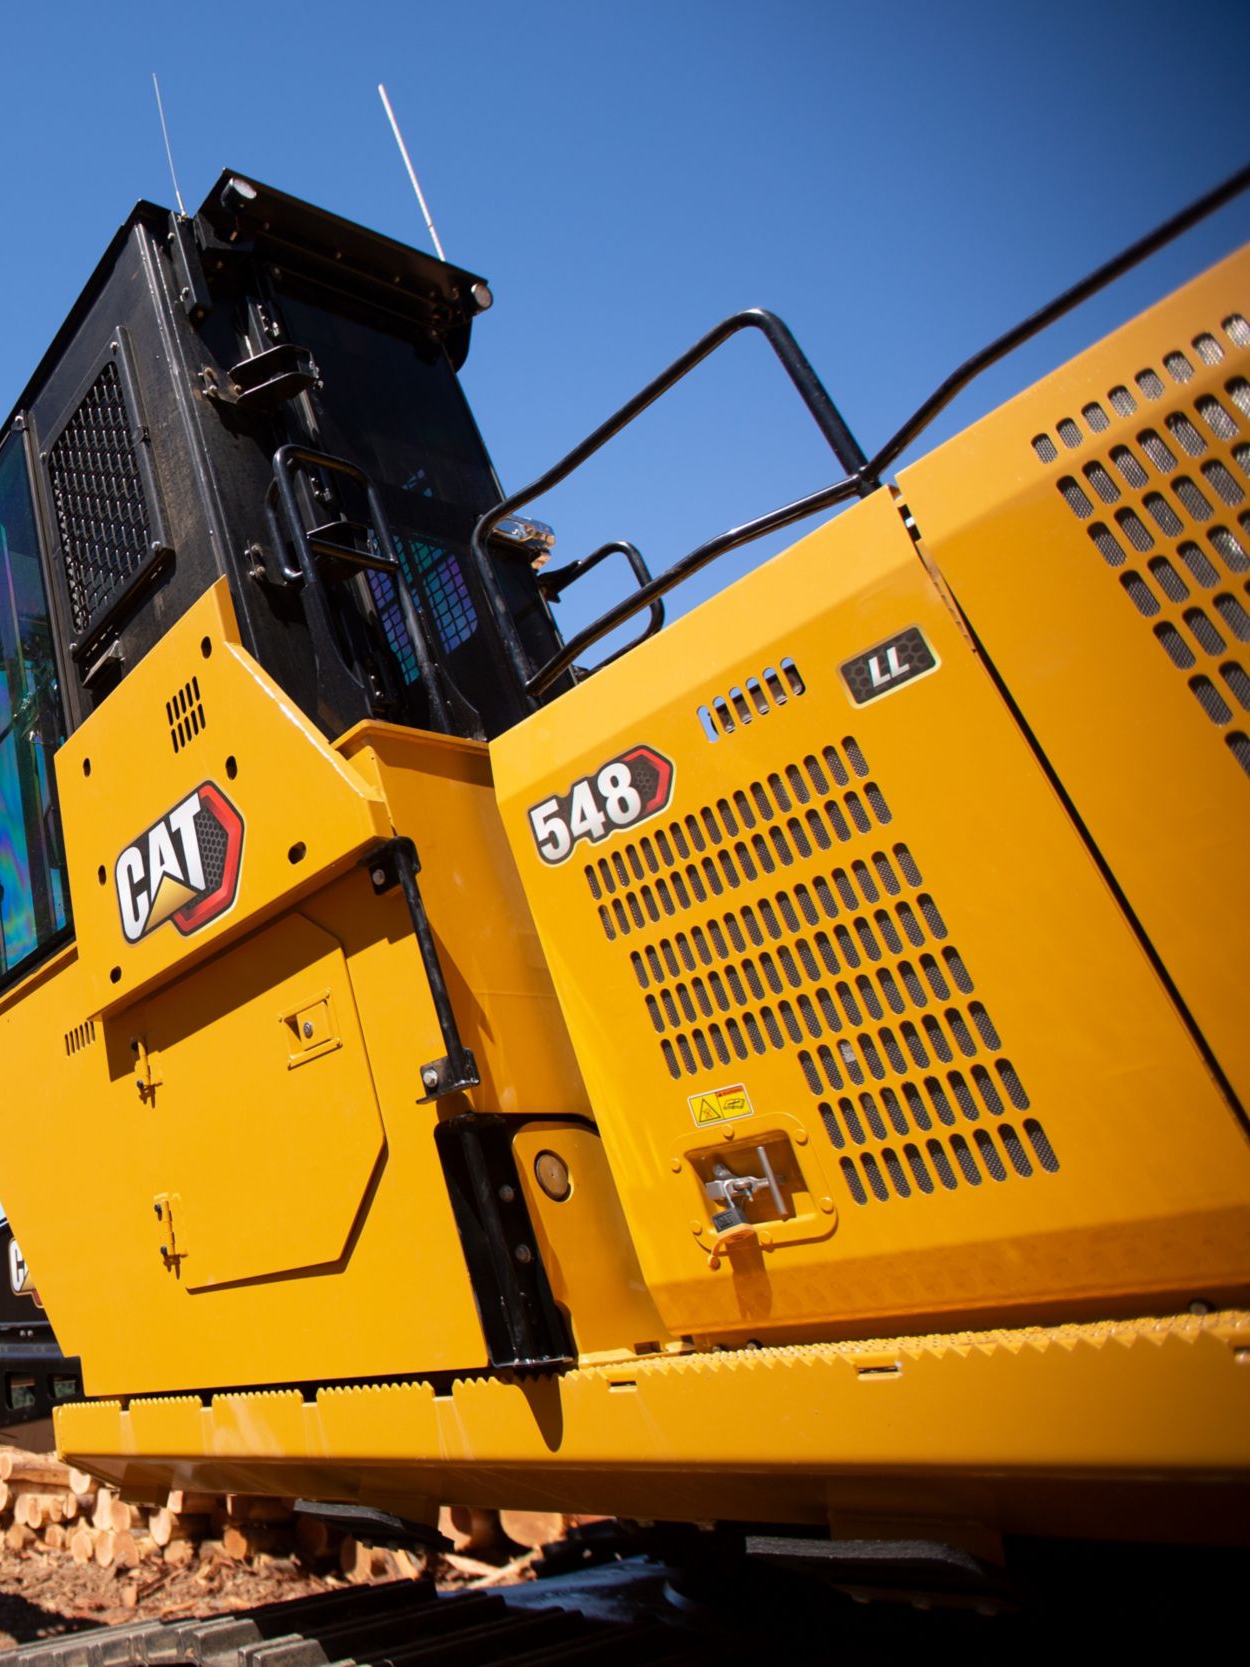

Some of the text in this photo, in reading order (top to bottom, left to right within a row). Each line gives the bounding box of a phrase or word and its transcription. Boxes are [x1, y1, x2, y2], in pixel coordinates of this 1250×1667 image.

[868, 646, 910, 688] LL
[530, 762, 642, 861] 548
[115, 792, 207, 940] CAT
